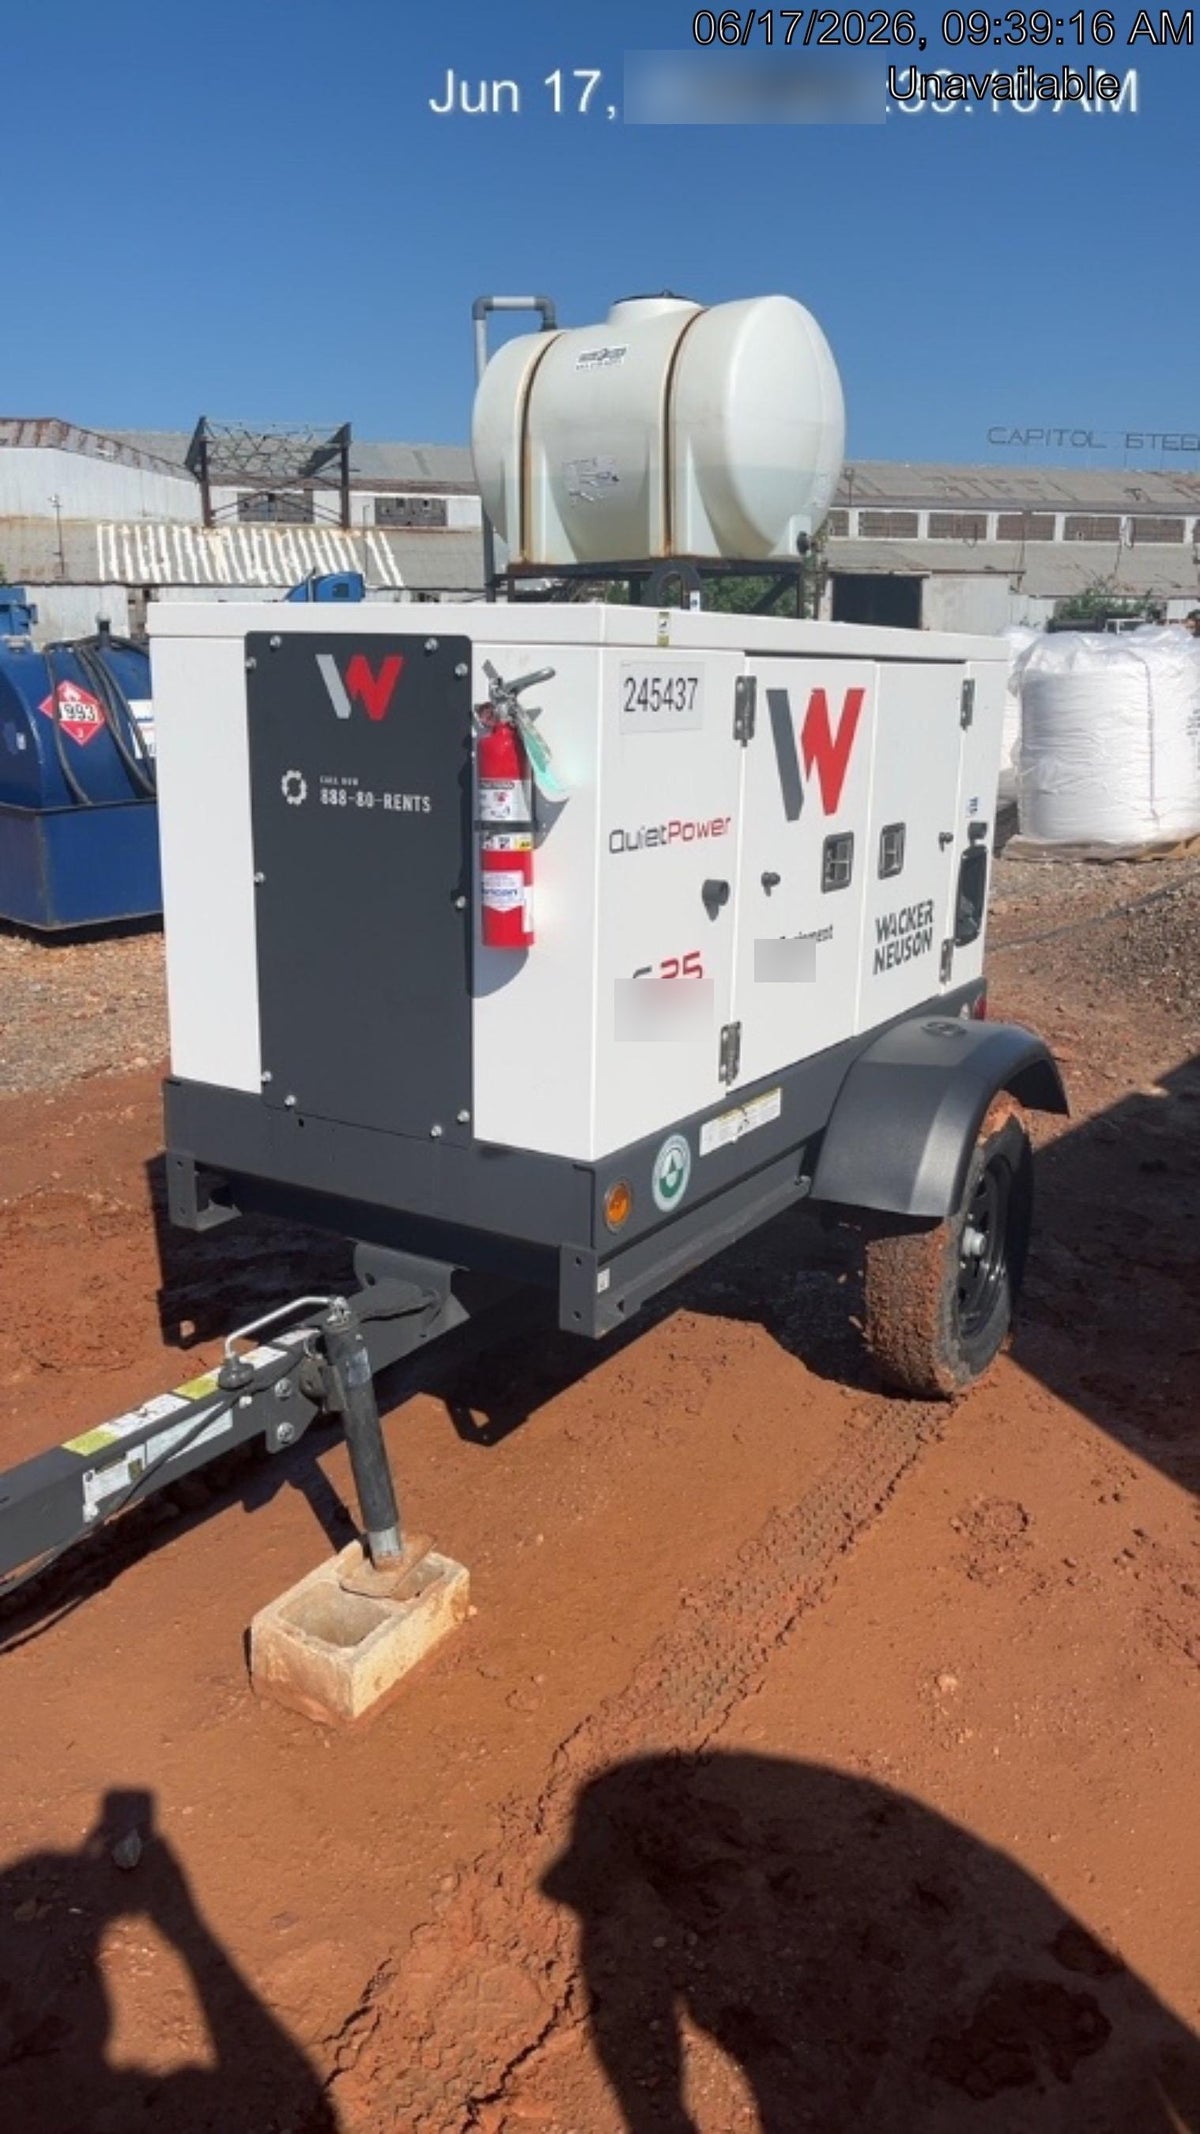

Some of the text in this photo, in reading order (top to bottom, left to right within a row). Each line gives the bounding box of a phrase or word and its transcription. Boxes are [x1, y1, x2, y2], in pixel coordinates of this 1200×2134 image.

[987, 426, 1200, 451] CAPITOL STEE
[623, 677, 699, 712] 245437
[320, 788, 433, 814] 888-80-RENTS
[609, 817, 732, 854] QuietPower
[875, 899, 934, 944] WACKER
[873, 927, 933, 975] NEUSON
